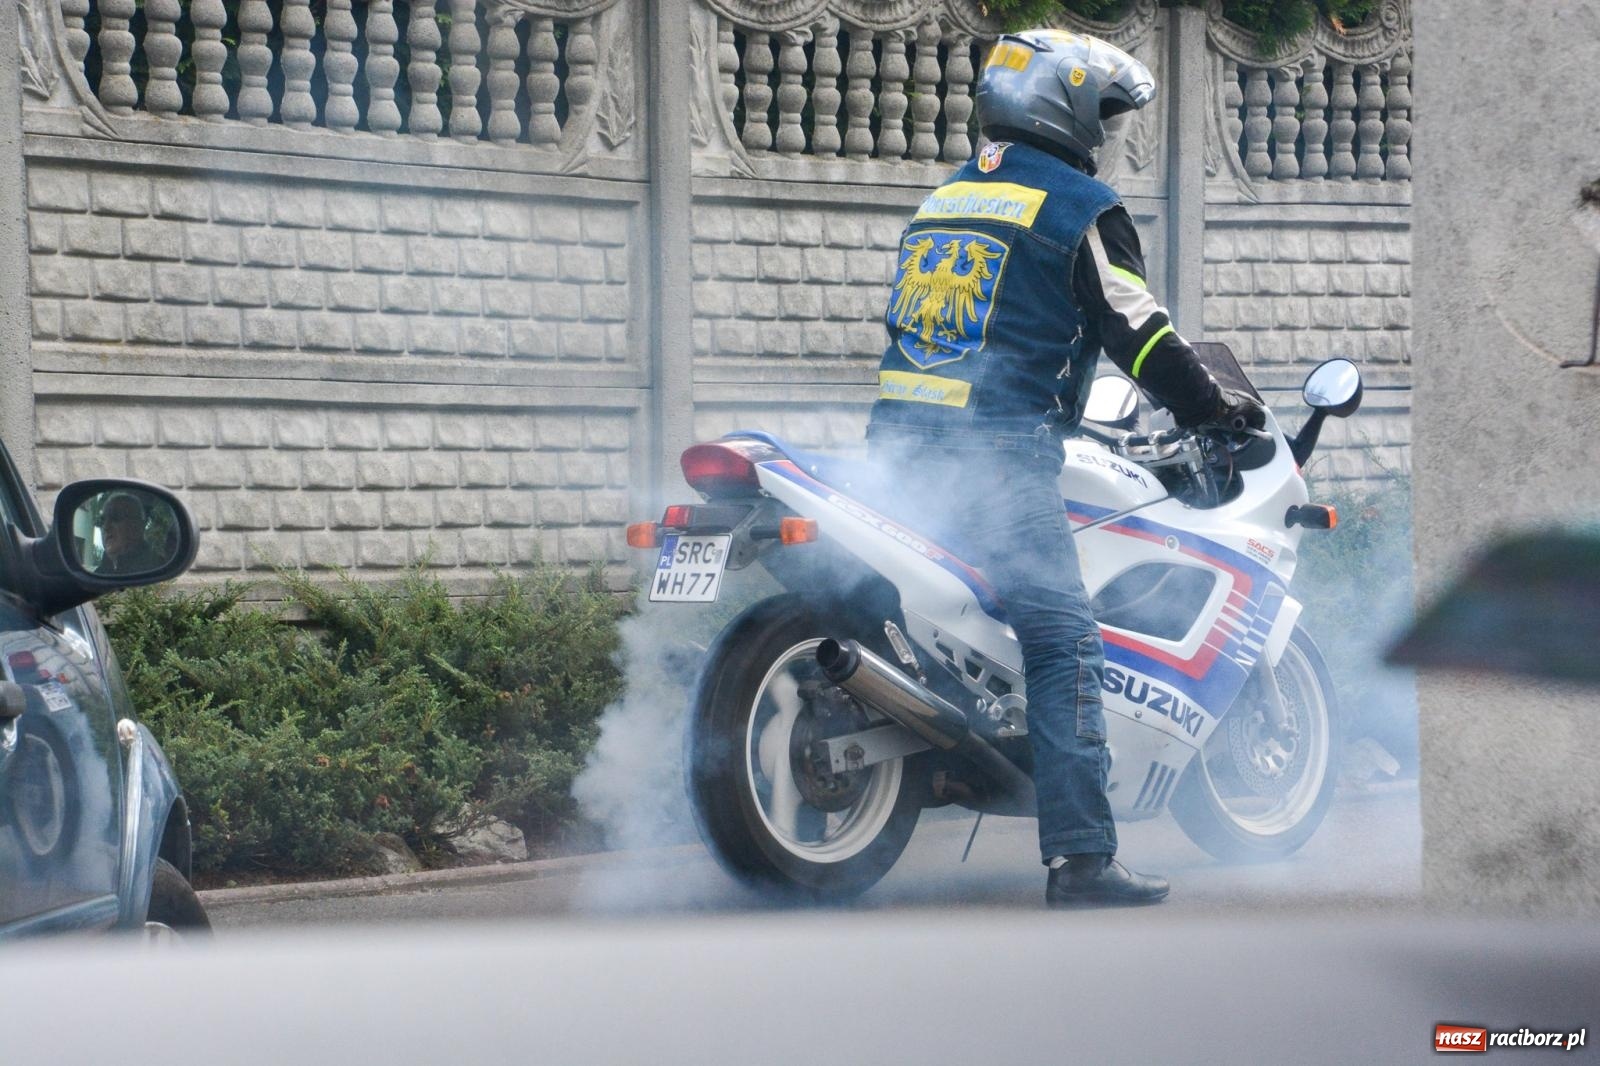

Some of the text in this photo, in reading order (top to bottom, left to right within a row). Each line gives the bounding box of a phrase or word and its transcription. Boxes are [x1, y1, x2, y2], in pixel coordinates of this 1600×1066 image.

[1076, 453, 1148, 488] SUZUKI
[660, 555, 672, 566] PL
[675, 541, 716, 564] SRC
[656, 572, 716, 595] WH77
[1101, 666, 1205, 738] SUZUKI
